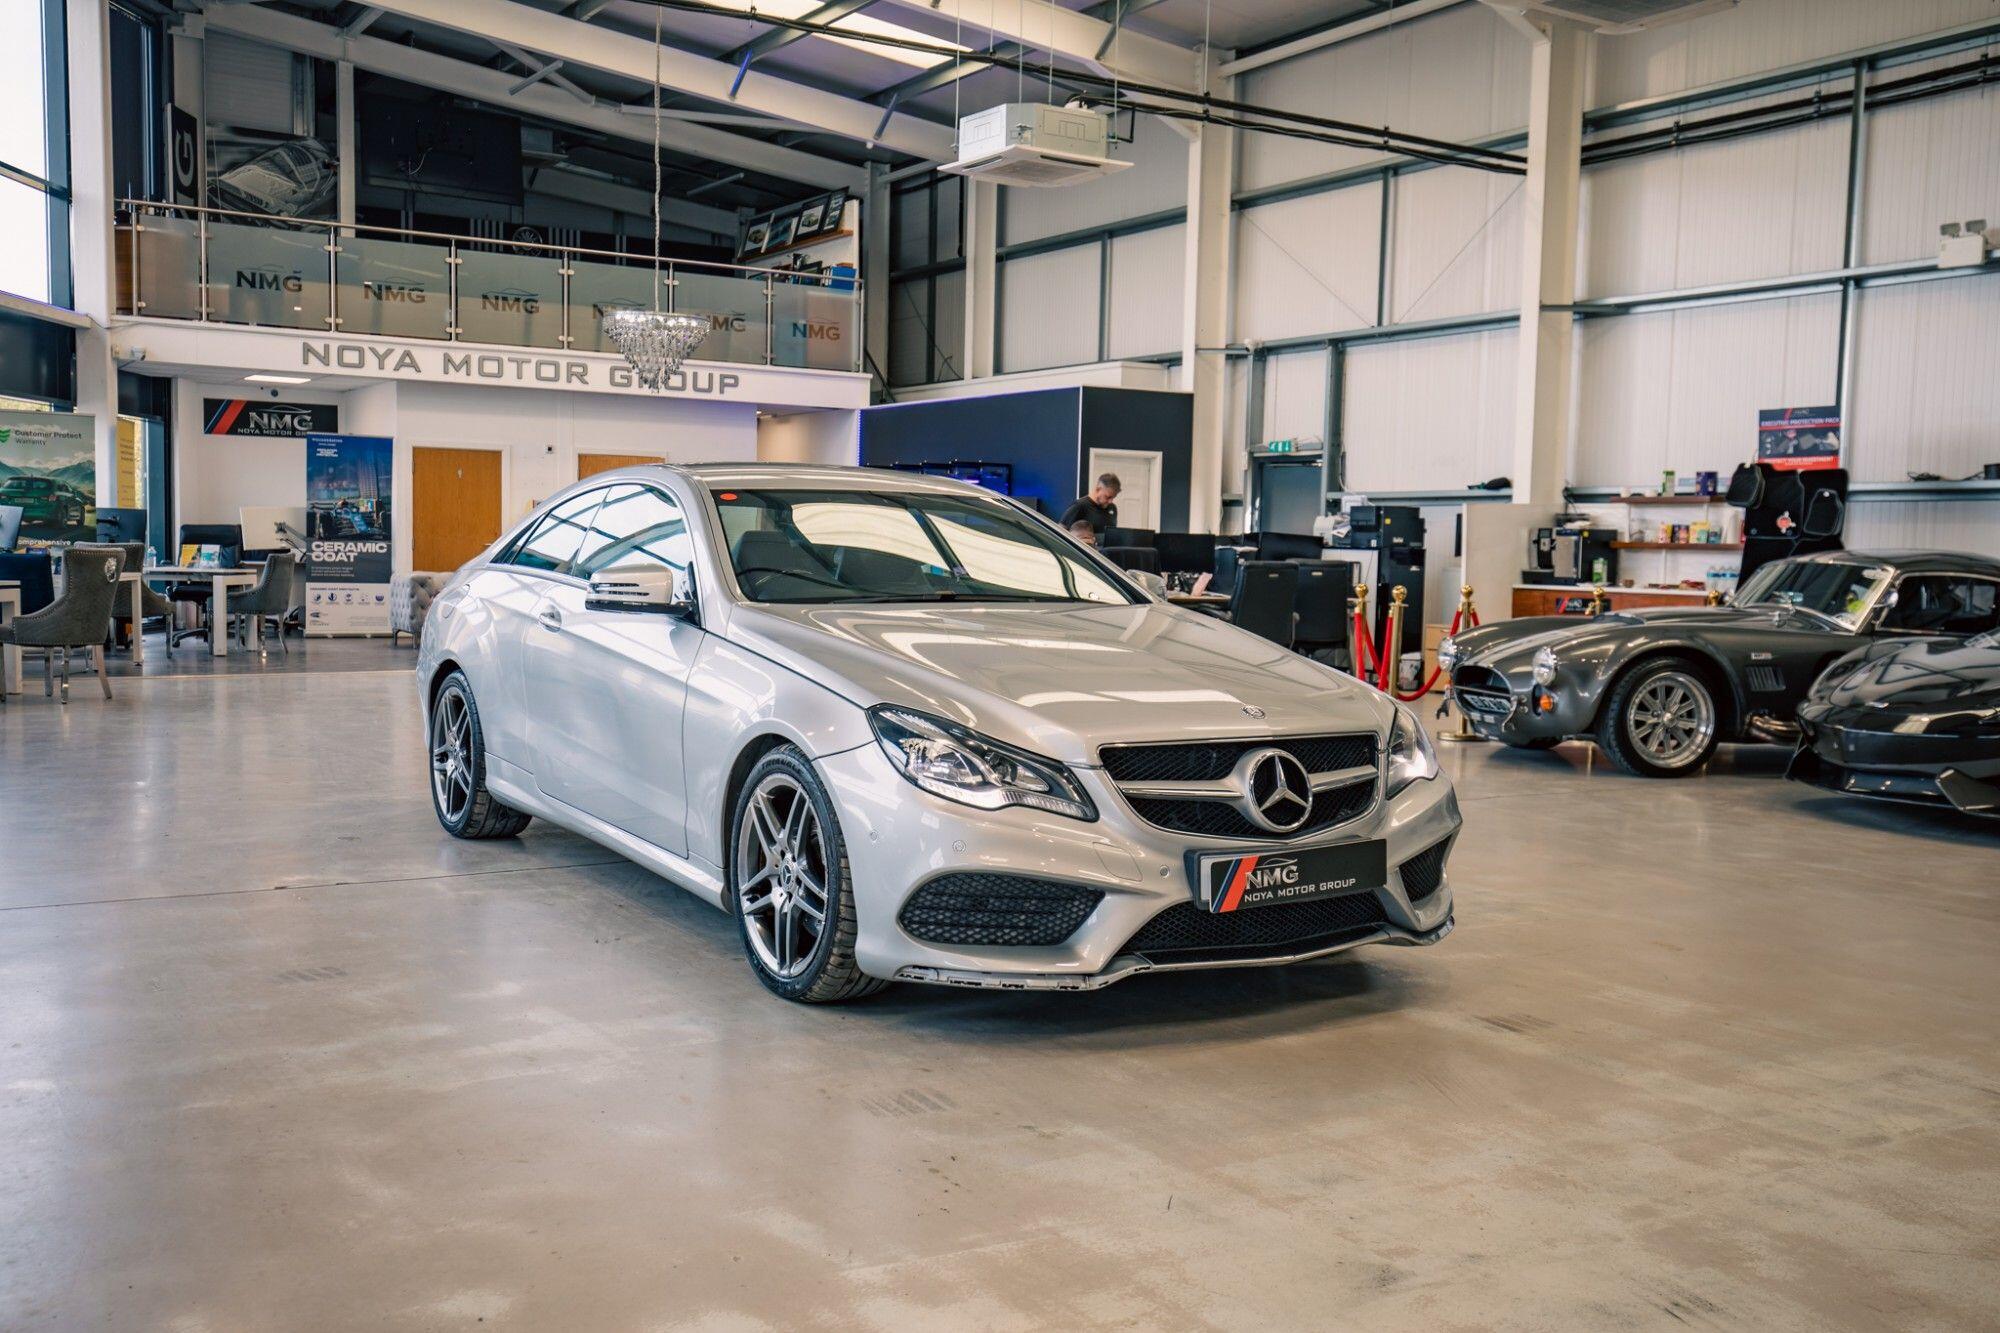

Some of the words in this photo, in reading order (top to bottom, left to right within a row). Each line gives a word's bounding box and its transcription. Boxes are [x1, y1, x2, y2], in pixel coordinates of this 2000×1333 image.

[236, 270, 302, 293] NMG
[364, 284, 426, 304] NMG
[481, 293, 540, 314] NMG
[707, 315, 746, 333] MG
[792, 322, 841, 341] NMG
[302, 341, 422, 373] NOYA
[443, 352, 589, 385] MOTOR
[248, 411, 313, 431] NMG
[14, 430, 52, 438] Customer
[53, 431, 82, 440] Protect
[18, 539, 71, 547] omprehensive
[311, 541, 388, 553] CERAMIC
[311, 551, 358, 562] COAT
[1245, 865, 1299, 890] NMG
[1244, 892, 1274, 903] NOYA
[1278, 884, 1316, 897] MOTOR
[1319, 878, 1356, 891] GROUP
